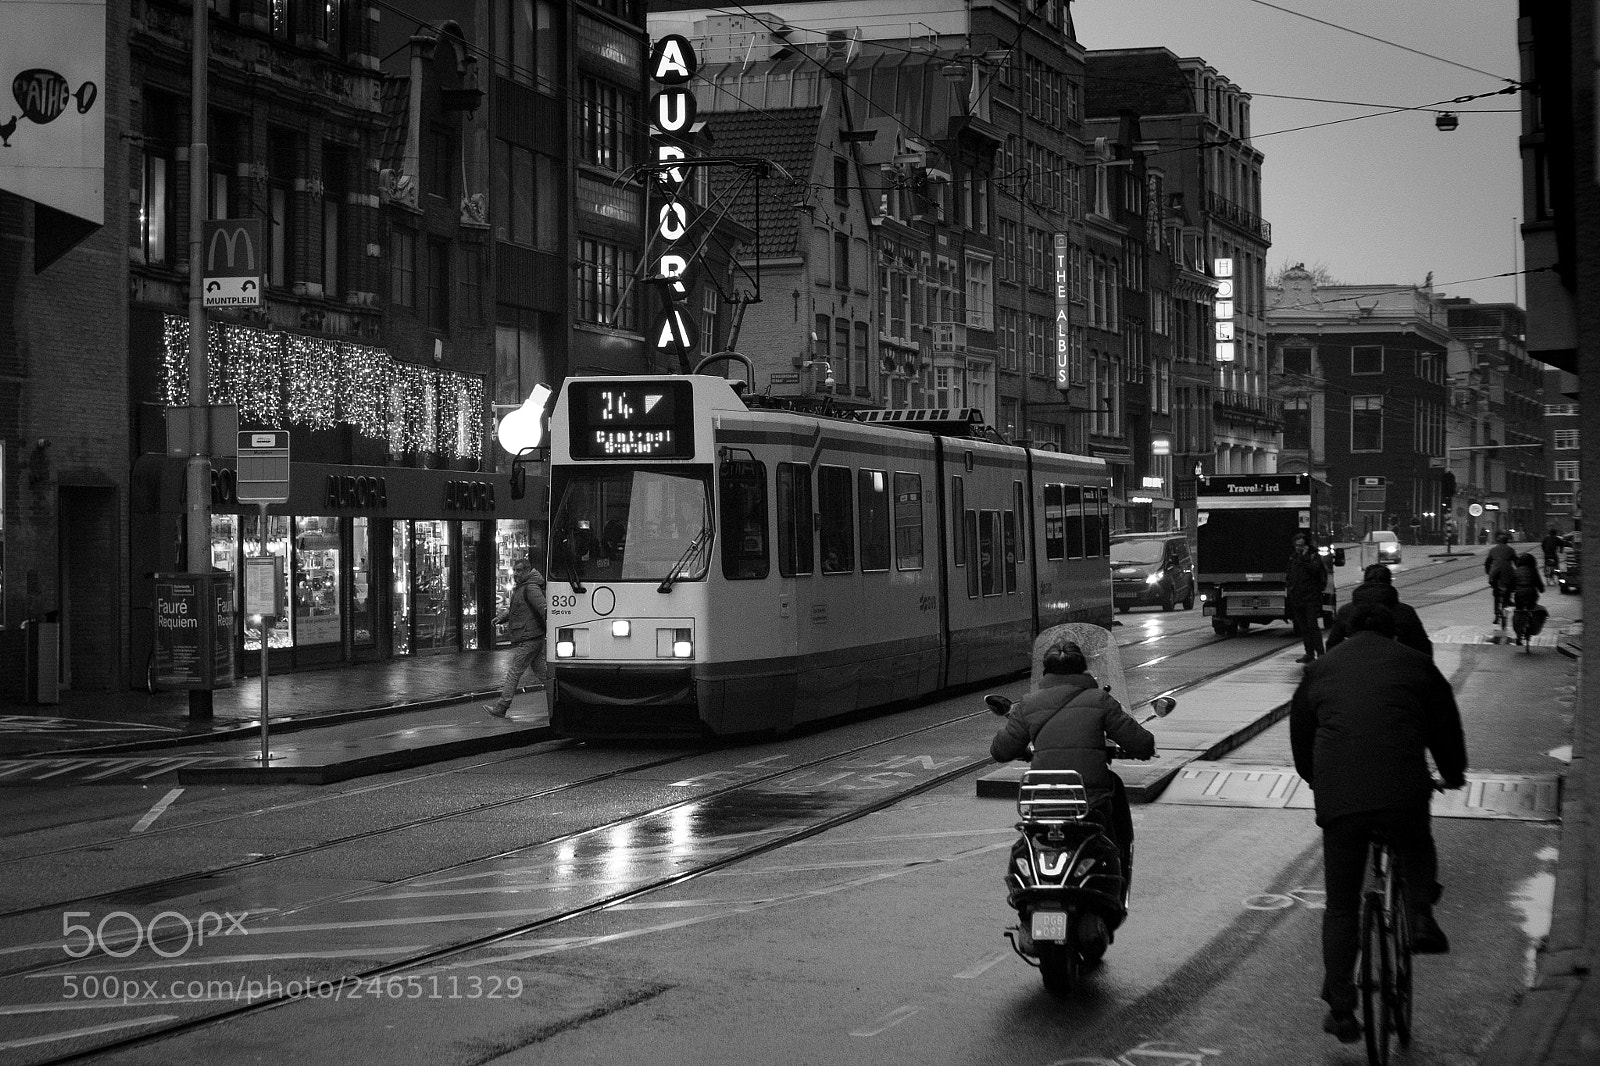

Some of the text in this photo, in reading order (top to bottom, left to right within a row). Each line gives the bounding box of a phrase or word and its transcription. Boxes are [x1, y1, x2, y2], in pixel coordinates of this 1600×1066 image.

[655, 40, 691, 347] AURORA
[206, 297, 257, 305] MUNTPLEIN
[1217, 260, 1232, 360] HOTEL
[1056, 255, 1068, 382] THE ALBUS
[325, 475, 387, 509] AURORA
[443, 480, 495, 511] AURORA
[158, 598, 188, 614] Fauré
[552, 595, 576, 607] 830
[158, 615, 198, 631] Requiem
